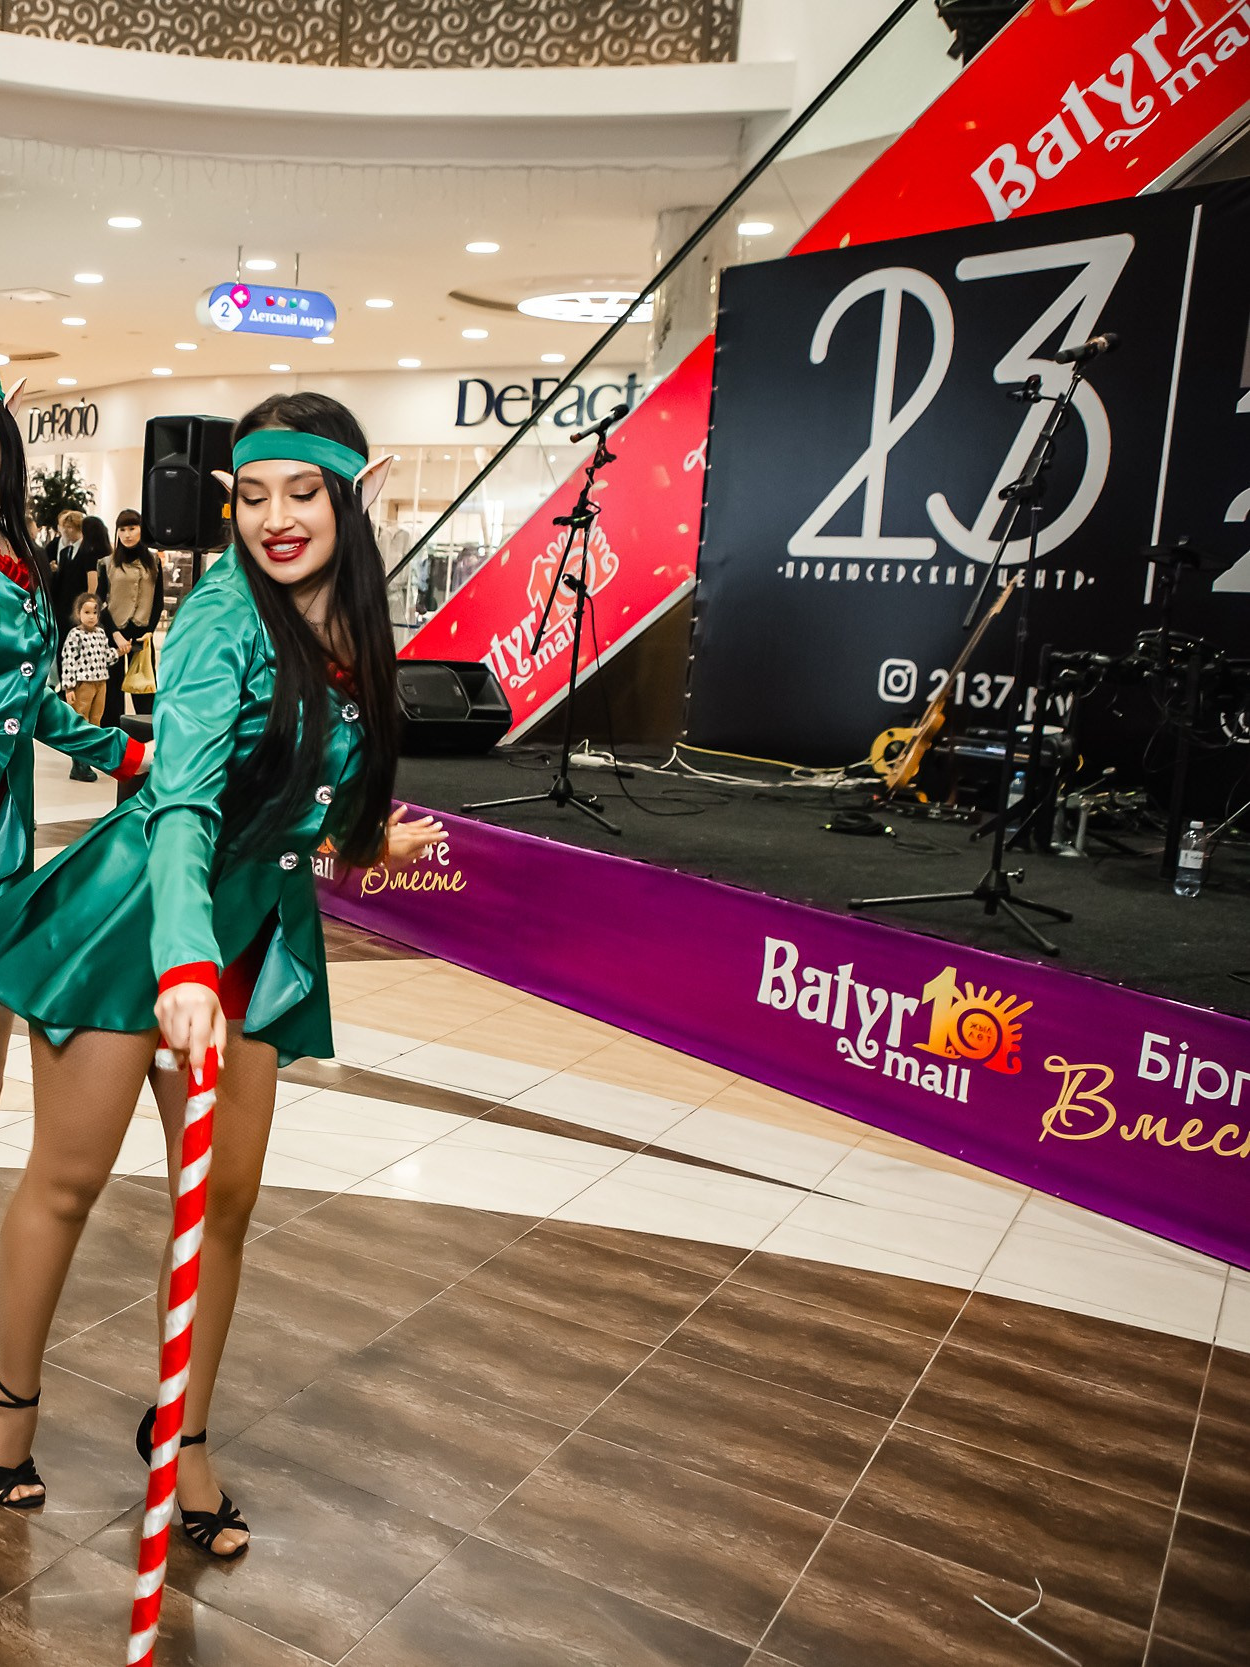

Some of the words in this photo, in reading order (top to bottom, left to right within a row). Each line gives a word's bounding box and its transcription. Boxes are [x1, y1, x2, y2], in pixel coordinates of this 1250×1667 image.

[971, 16, 1167, 222] Batyr
[221, 302, 230, 318] 2
[249, 308, 298, 326] Детский
[299, 316, 325, 331] мир
[455, 372, 647, 427] DeFact
[479, 610, 538, 689] tyr
[757, 936, 920, 1070] Batyr
[882, 1050, 970, 1103] mall
